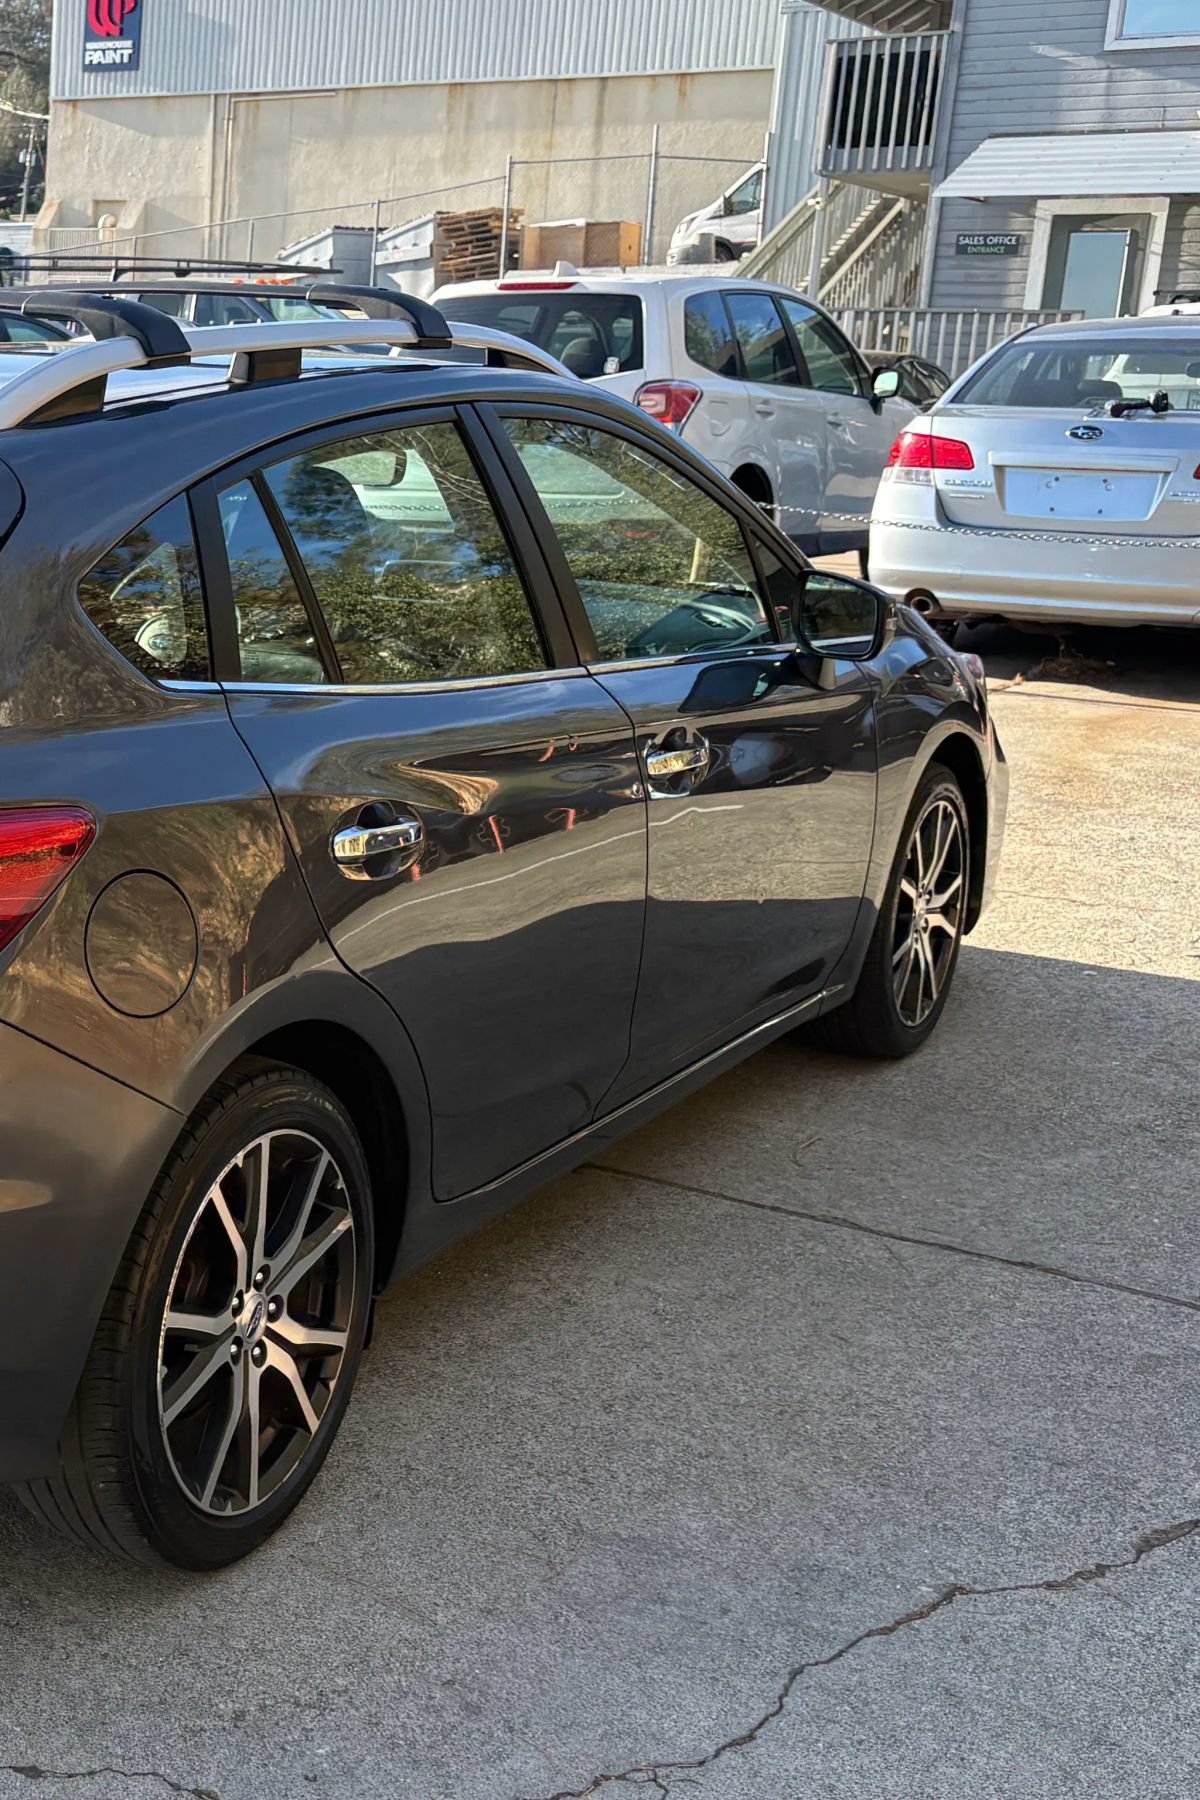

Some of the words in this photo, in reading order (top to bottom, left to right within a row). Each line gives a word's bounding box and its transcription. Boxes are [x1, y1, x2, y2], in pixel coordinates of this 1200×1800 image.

[85, 49, 133, 65] PAINT
[959, 236, 984, 246] SALES
[987, 236, 1017, 246] OFFICE
[968, 246, 1004, 255] ENTRANCE
